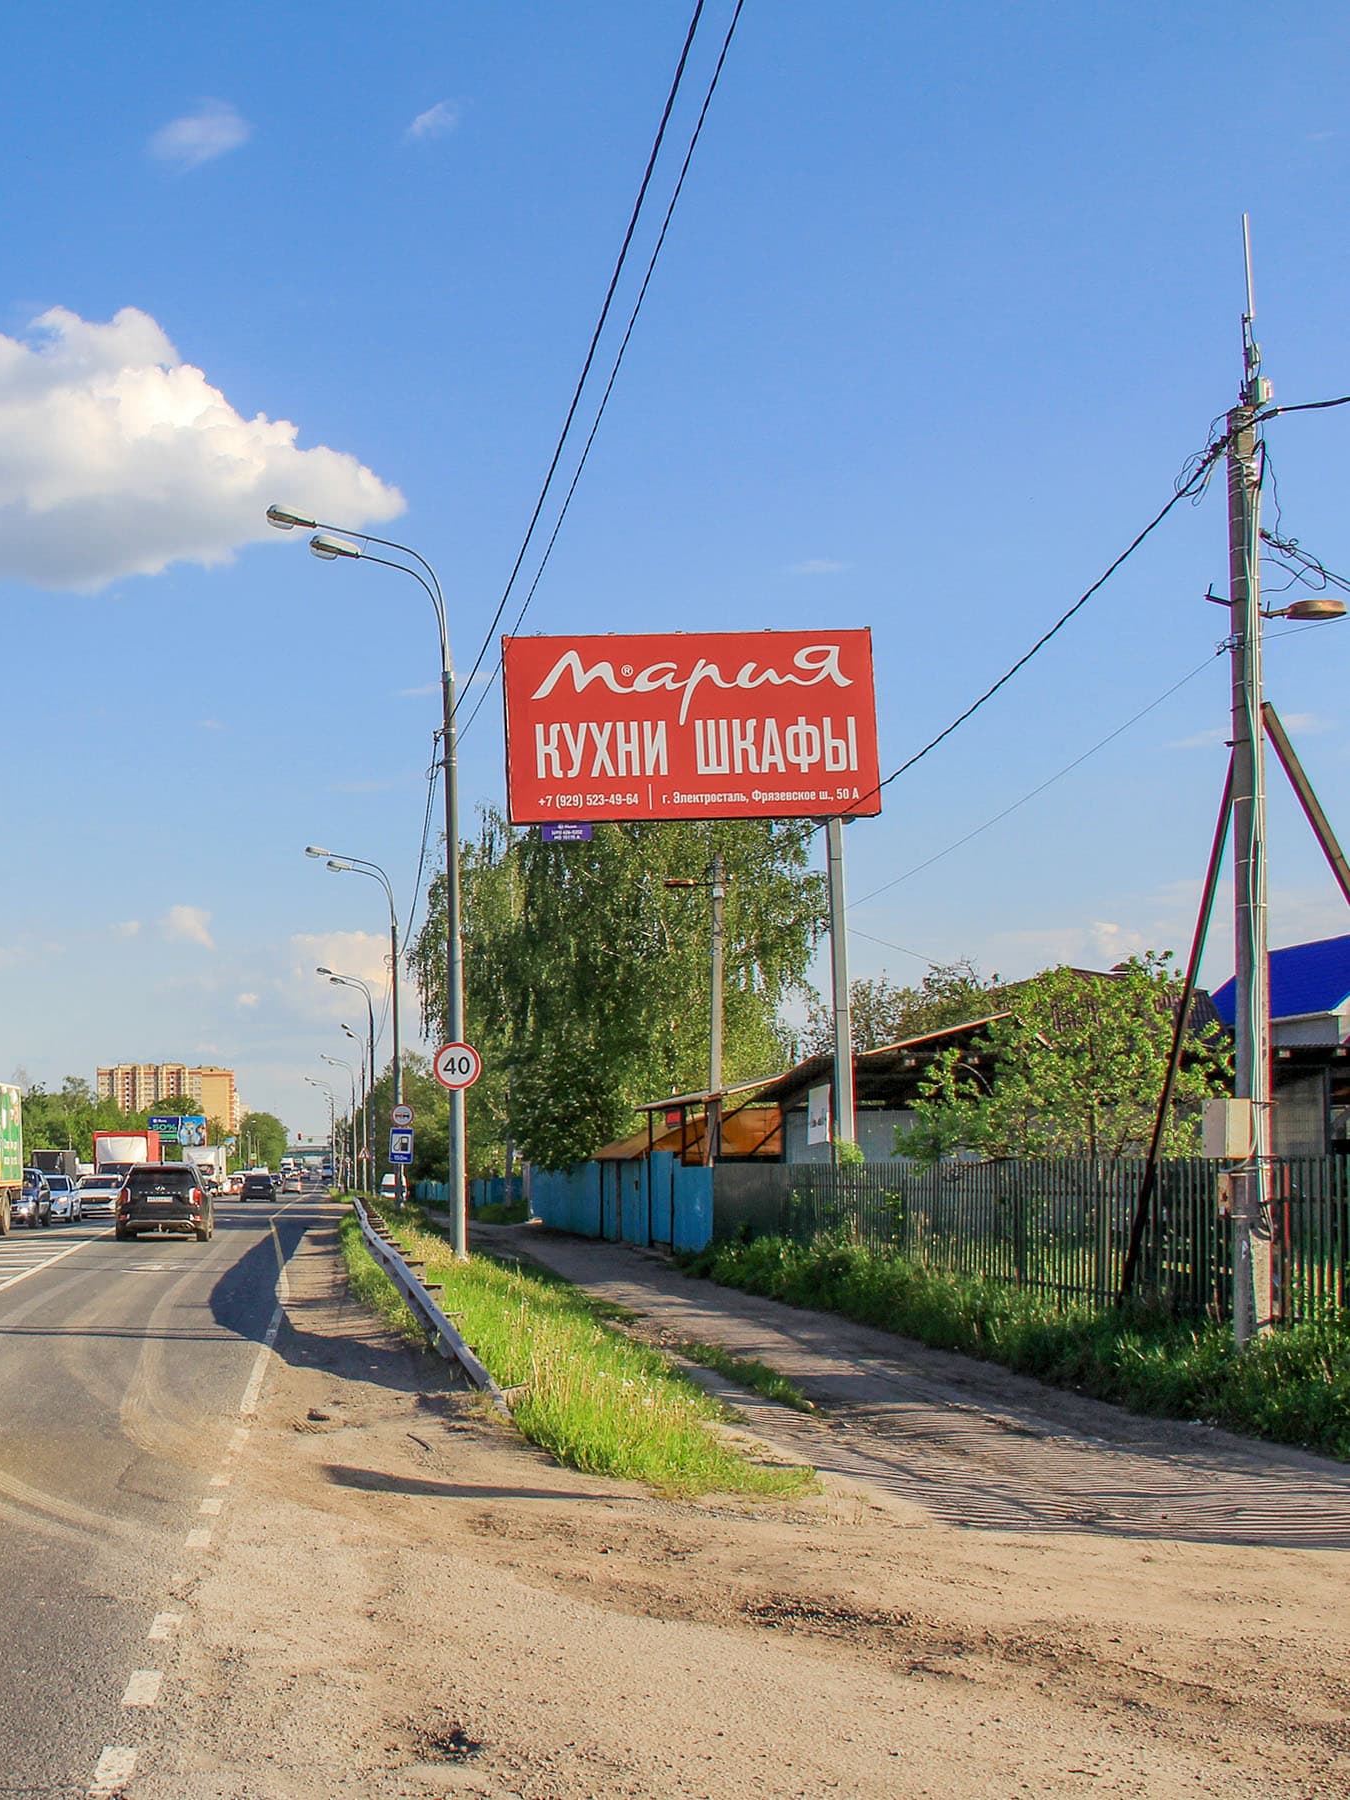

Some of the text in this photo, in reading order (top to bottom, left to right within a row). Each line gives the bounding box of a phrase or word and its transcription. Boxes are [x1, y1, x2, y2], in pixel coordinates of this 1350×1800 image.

[535, 716, 859, 779] КУХНИ ШКАФЫ
[538, 793, 639, 809] +7 (929) 523-49-64
[662, 794, 670, 804] г.
[673, 791, 749, 806] Электросталь,
[751, 789, 816, 803] Фрязевское
[819, 790, 834, 801] ш.,
[836, 788, 849, 799] 50
[443, 1056, 470, 1075] 40
